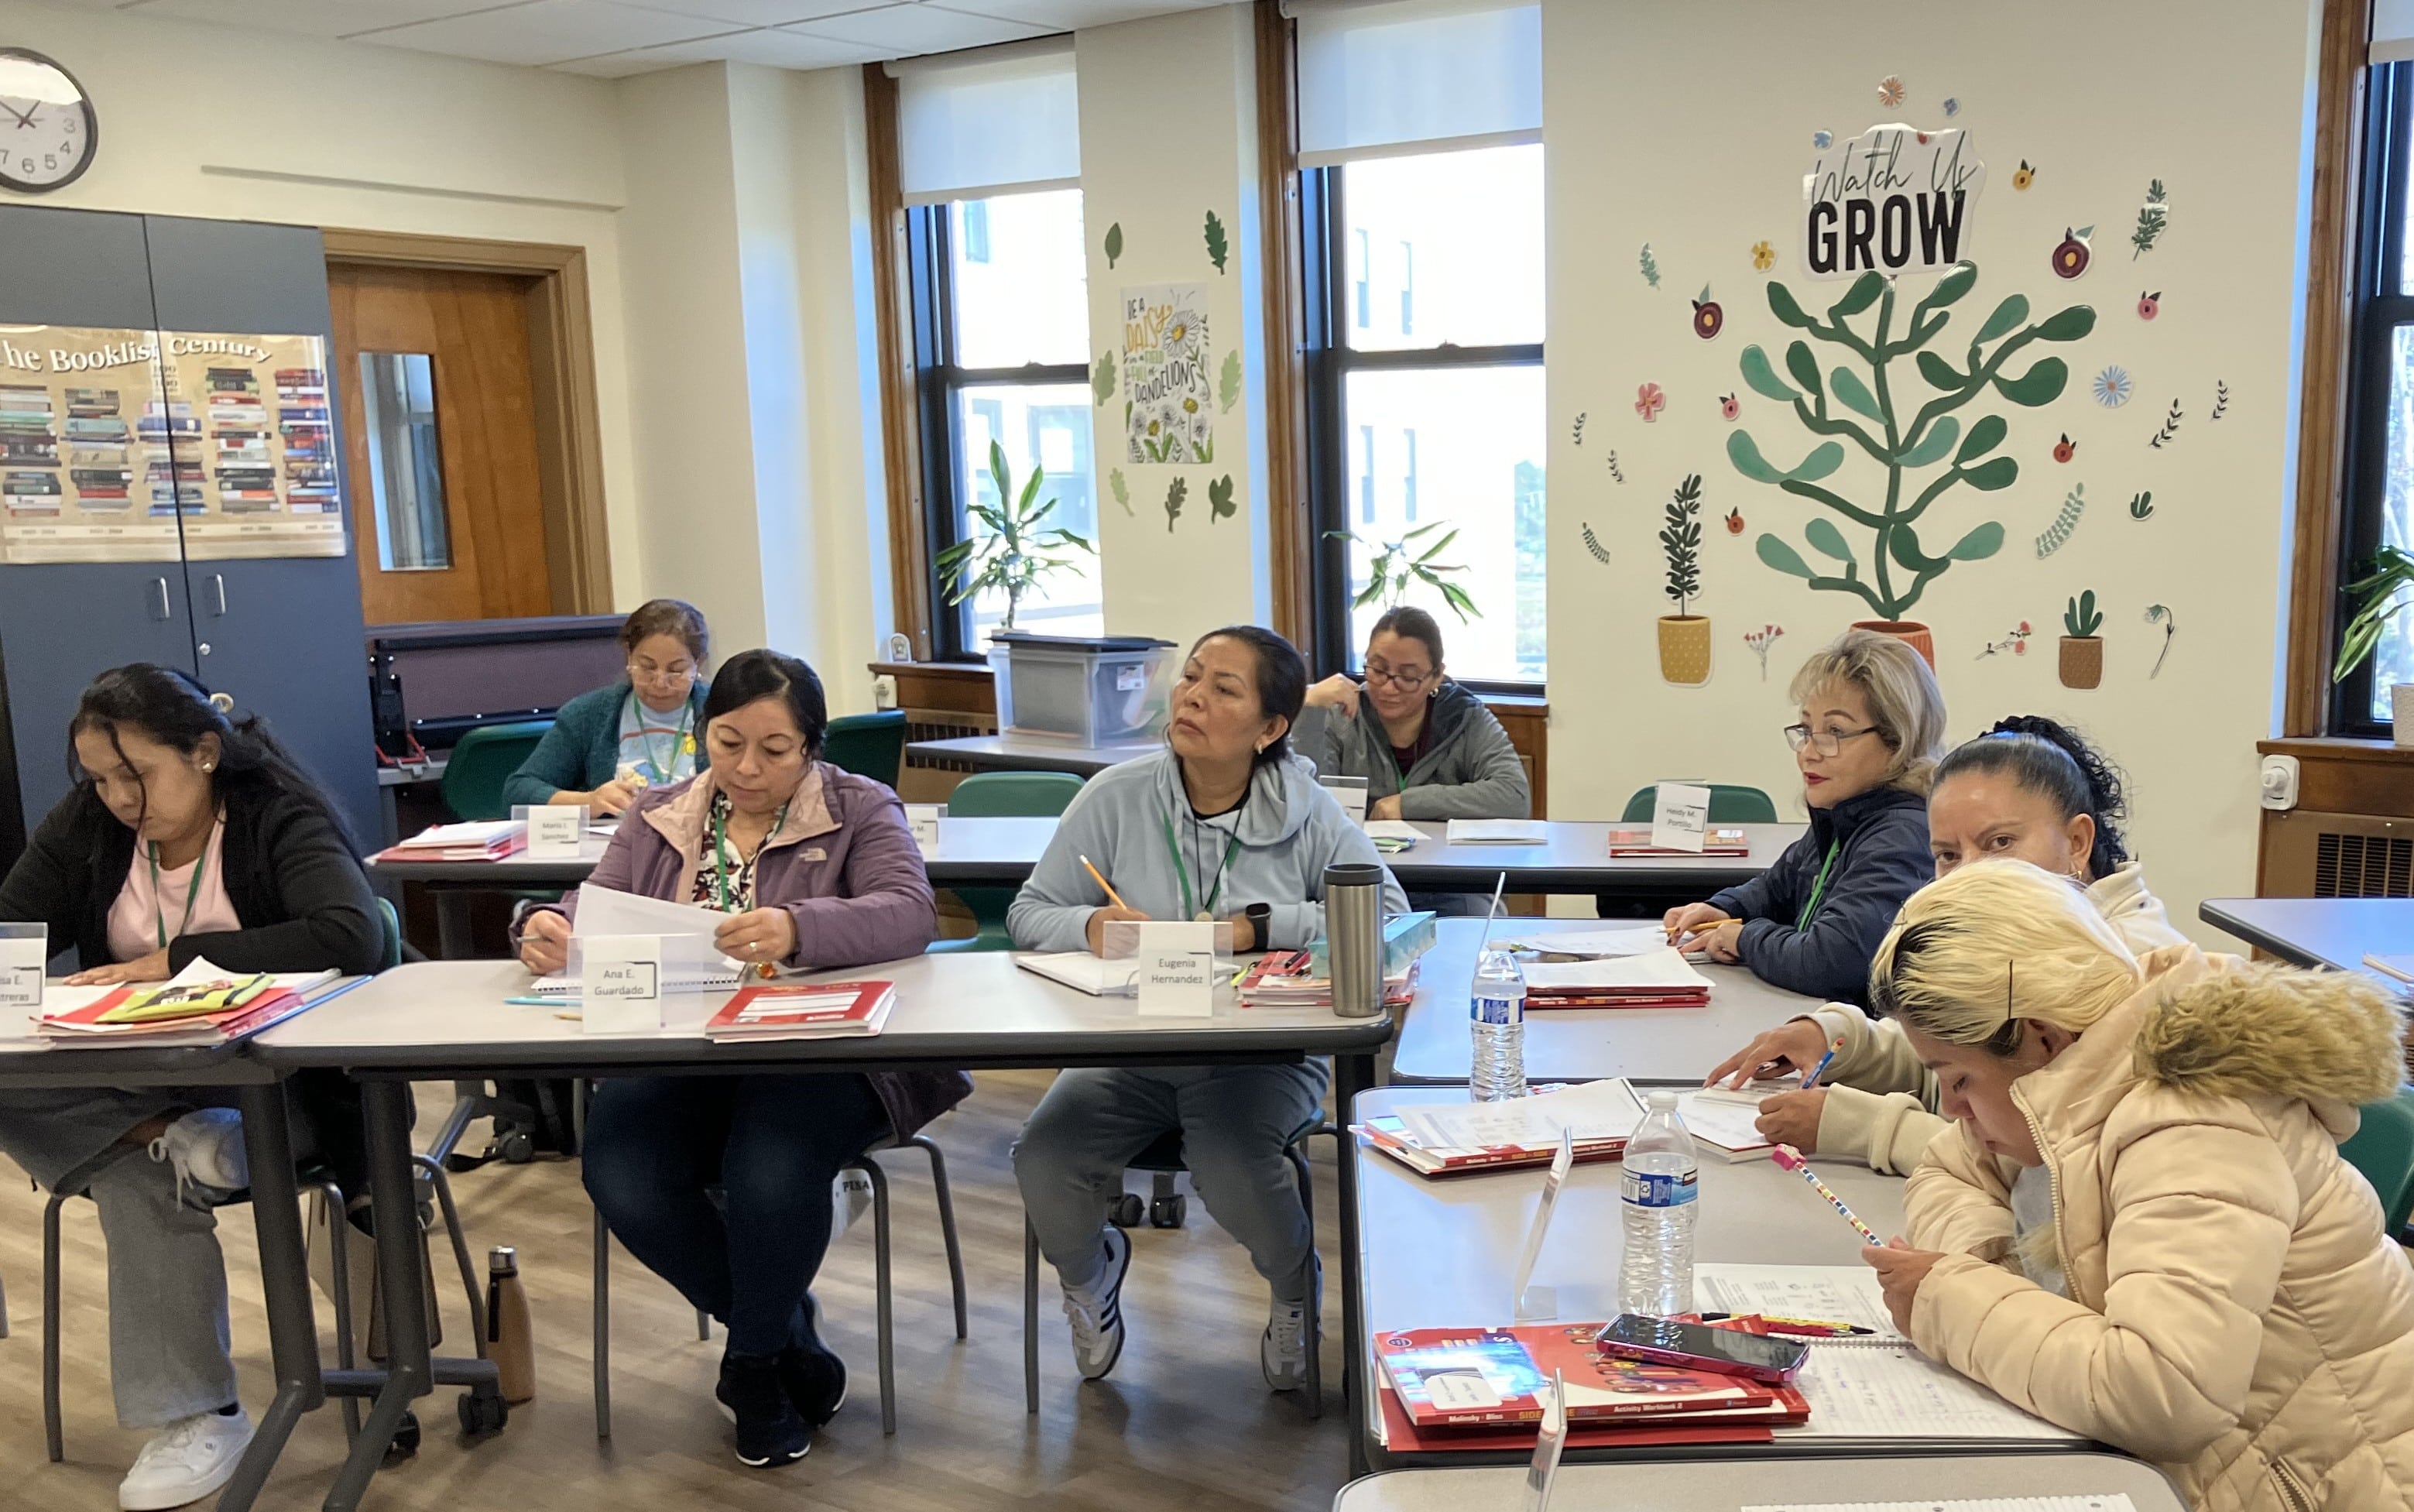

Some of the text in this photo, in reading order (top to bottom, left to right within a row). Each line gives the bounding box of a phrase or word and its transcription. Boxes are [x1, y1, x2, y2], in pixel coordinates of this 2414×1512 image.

[63, 117, 77, 134] 3
[60, 140, 71, 155] 4
[22, 157, 36, 173] 6
[44, 153, 57, 170] 5
[1812, 130, 1978, 204] Watch Us
[1808, 190, 1967, 273] GROW
[0, 339, 43, 372] he
[167, 336, 273, 363] Century
[1134, 360, 1196, 403] DANDELIONS
[1158, 958, 1196, 969] Eugenia
[603, 969, 635, 979] Ana E.
[1151, 974, 1203, 984] Hernandez
[594, 985, 644, 996] Guardado
[1519, 1410, 1542, 1420] SIDE
